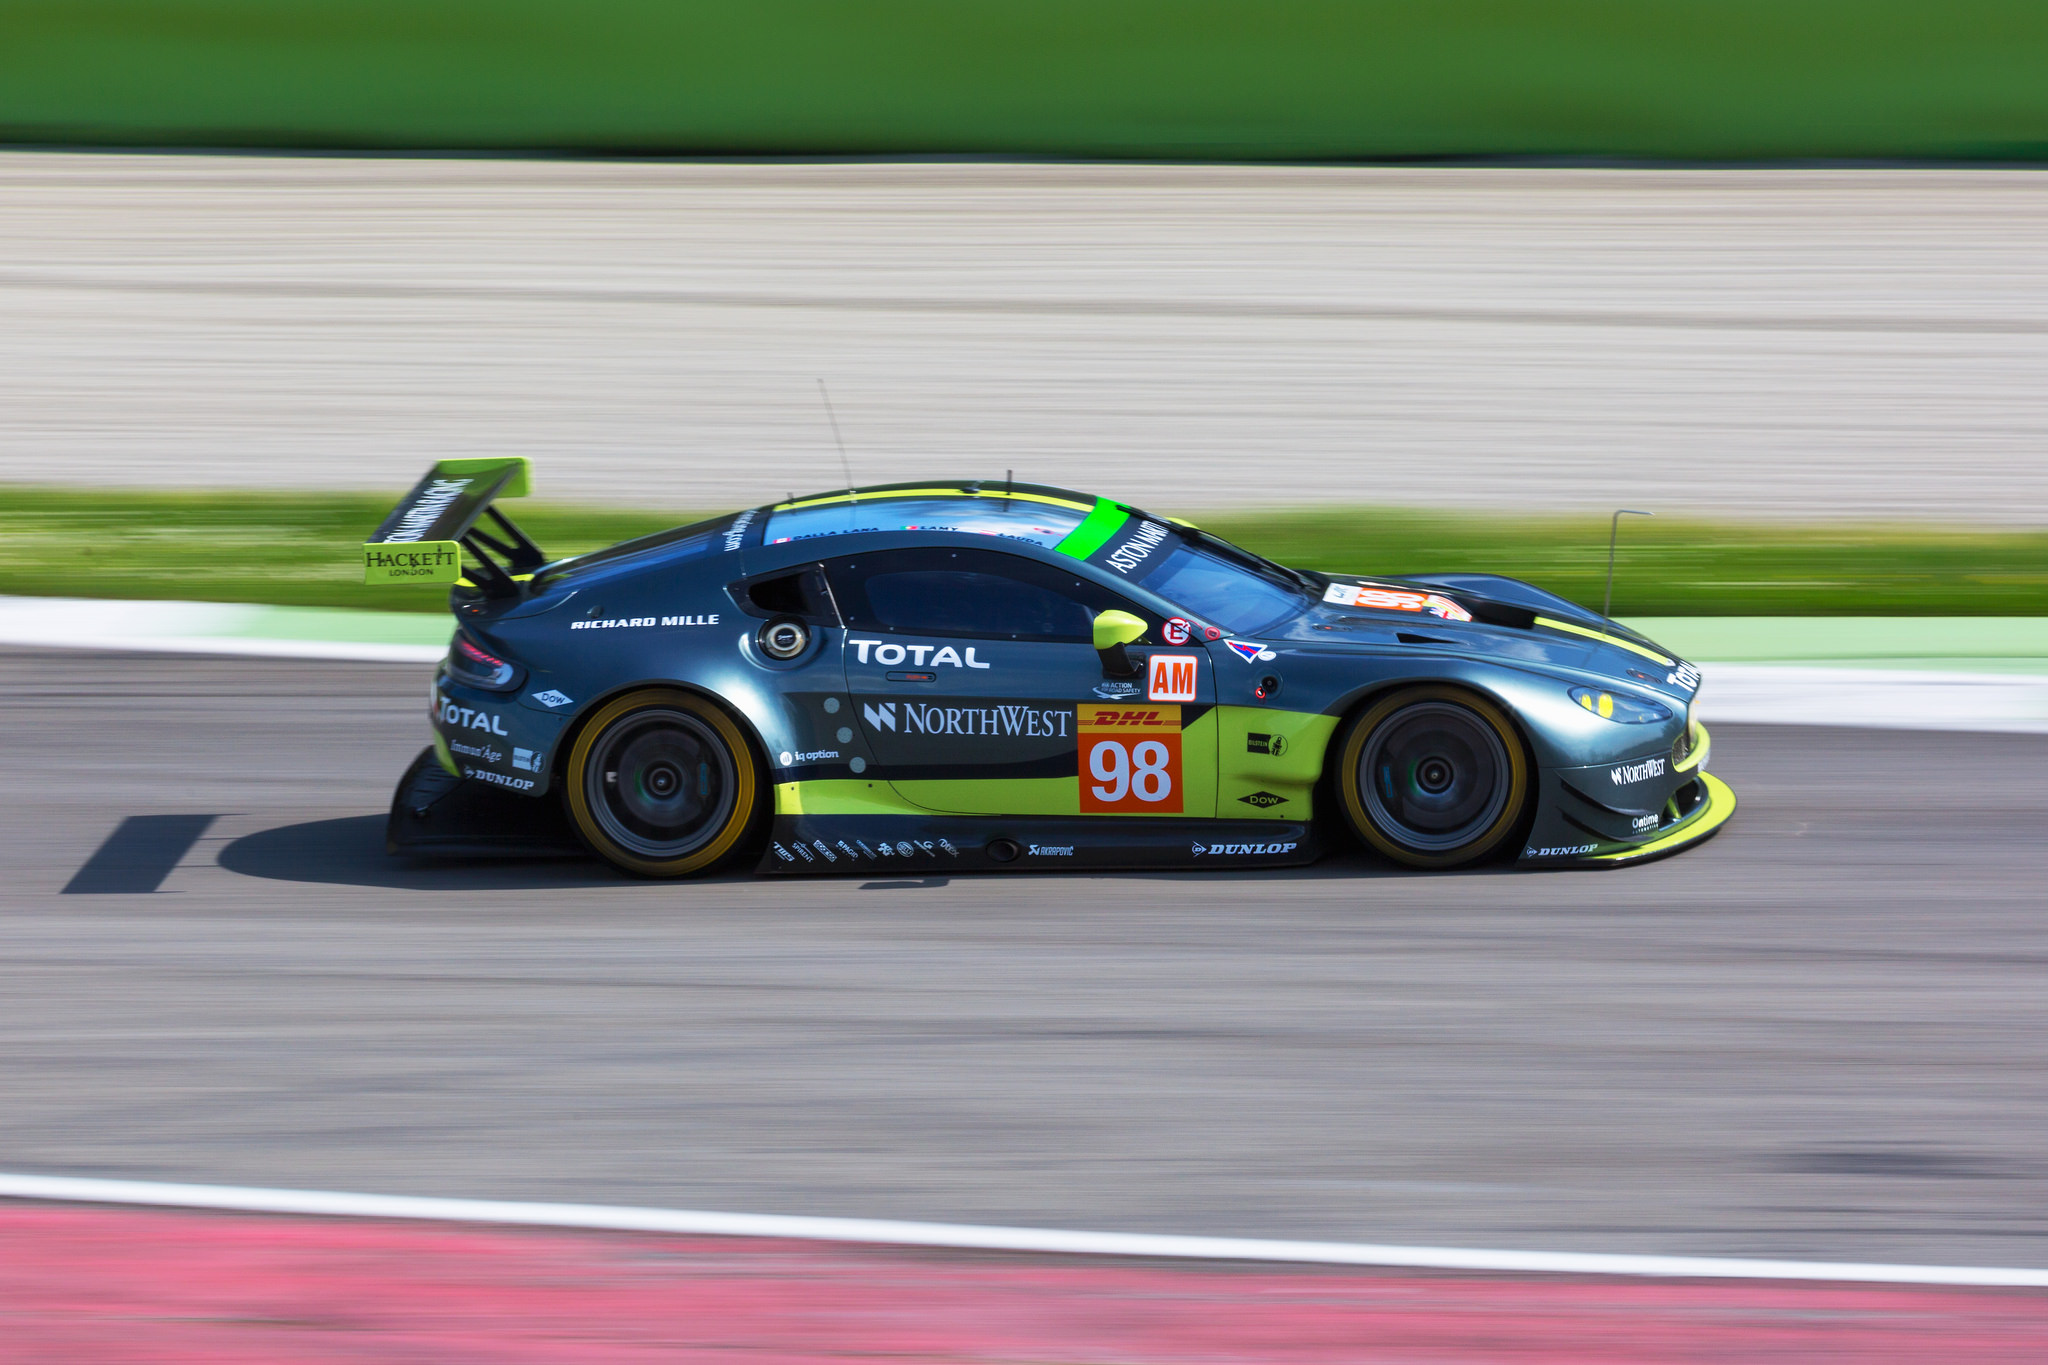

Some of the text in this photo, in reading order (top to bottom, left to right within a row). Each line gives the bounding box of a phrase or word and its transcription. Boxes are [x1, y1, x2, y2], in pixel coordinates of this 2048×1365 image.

[366, 551, 455, 567] HACKETT
[1105, 537, 1156, 574] ASTON
[389, 569, 434, 577] LONDON
[571, 615, 719, 630] RICHARD MILLE
[848, 640, 990, 669] TOTAL
[1152, 662, 1193, 694] AM
[541, 691, 566, 704] DOW
[440, 696, 508, 736] TOTAL
[903, 703, 1072, 737] NORTHWEST
[1094, 711, 1166, 726] DHL
[806, 749, 839, 761] option
[1089, 740, 1172, 802] 98
[1623, 758, 1666, 784] NORTHWEST
[475, 769, 535, 791] DUNLOP
[1250, 795, 1279, 804] DOW
[1207, 843, 1298, 855] DUNLOP
[1538, 844, 1599, 856] DUNLOP
